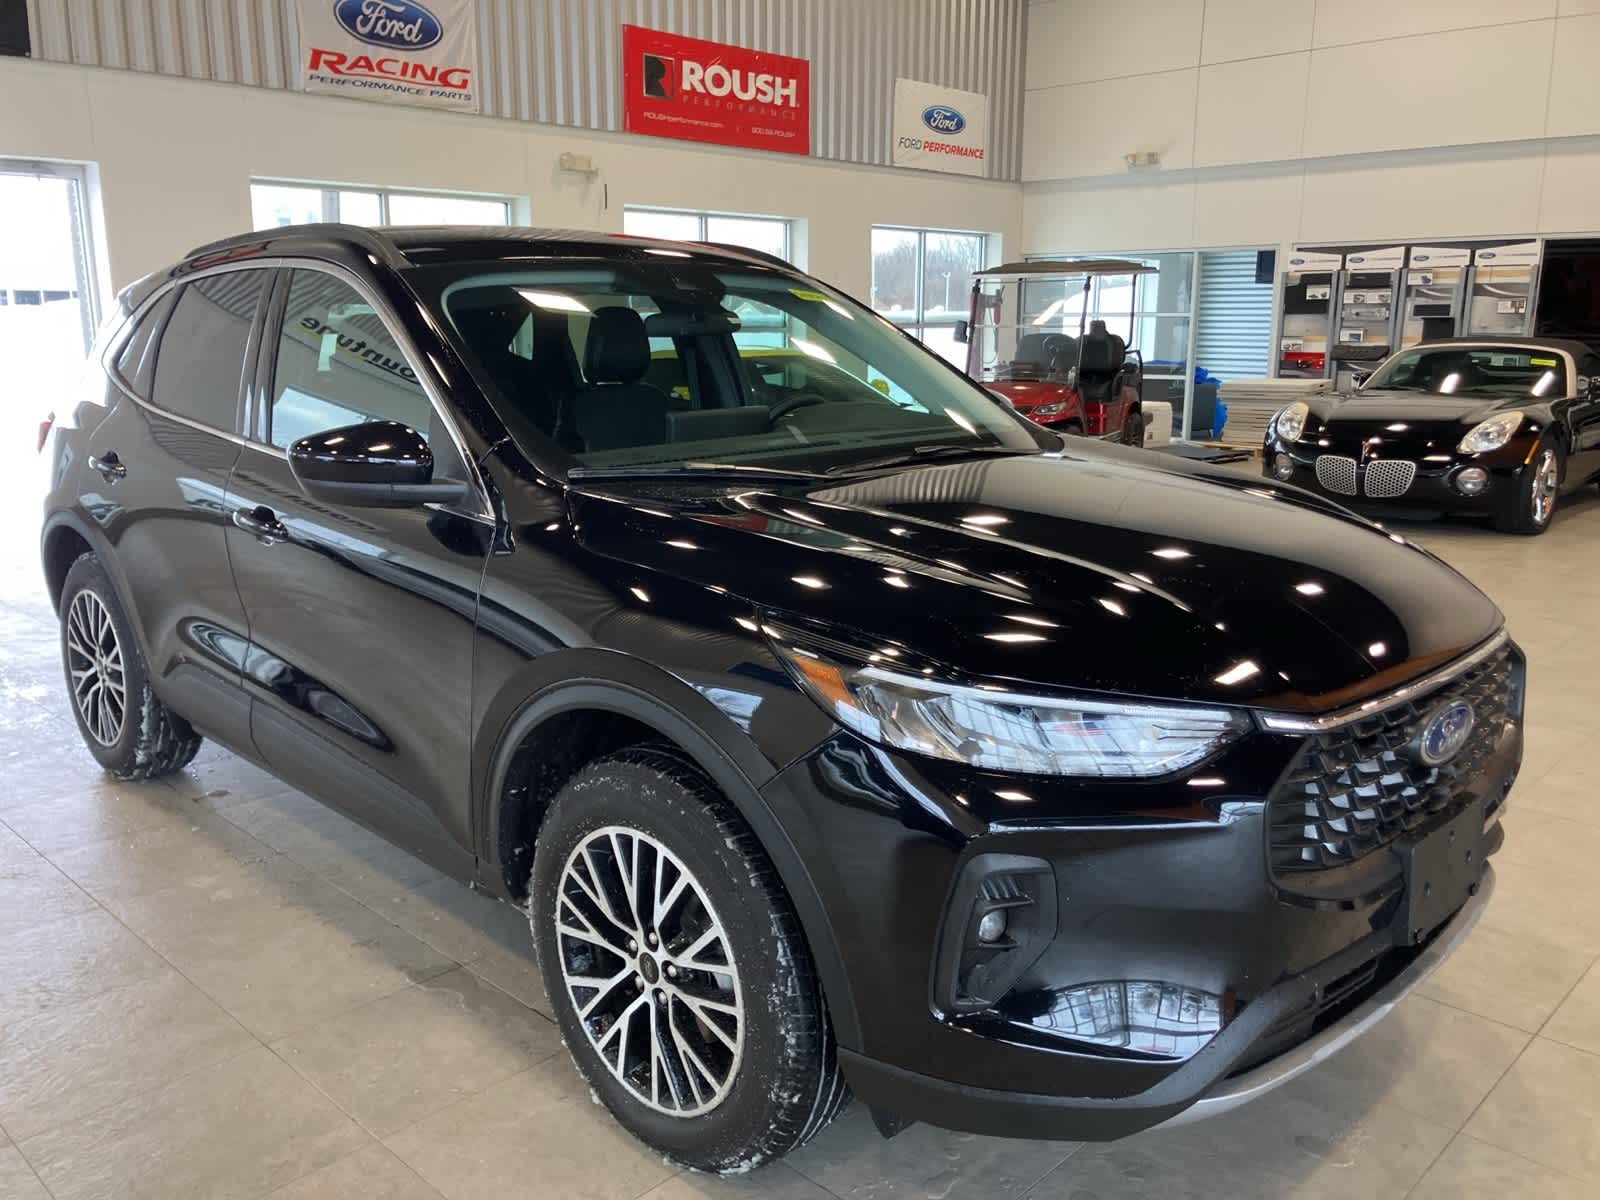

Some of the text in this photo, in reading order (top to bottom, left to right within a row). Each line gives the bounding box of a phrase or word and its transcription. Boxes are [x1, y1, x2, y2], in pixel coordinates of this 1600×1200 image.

[356, 0, 423, 43] Ford
[308, 48, 472, 90] RACING
[681, 58, 797, 107] ROUSH
[309, 74, 472, 101] PERFORMANCE PARTS
[683, 95, 797, 120] PERFORMANCE
[930, 109, 958, 130] Ford
[899, 137, 984, 160] FORD PERFORMANCE
